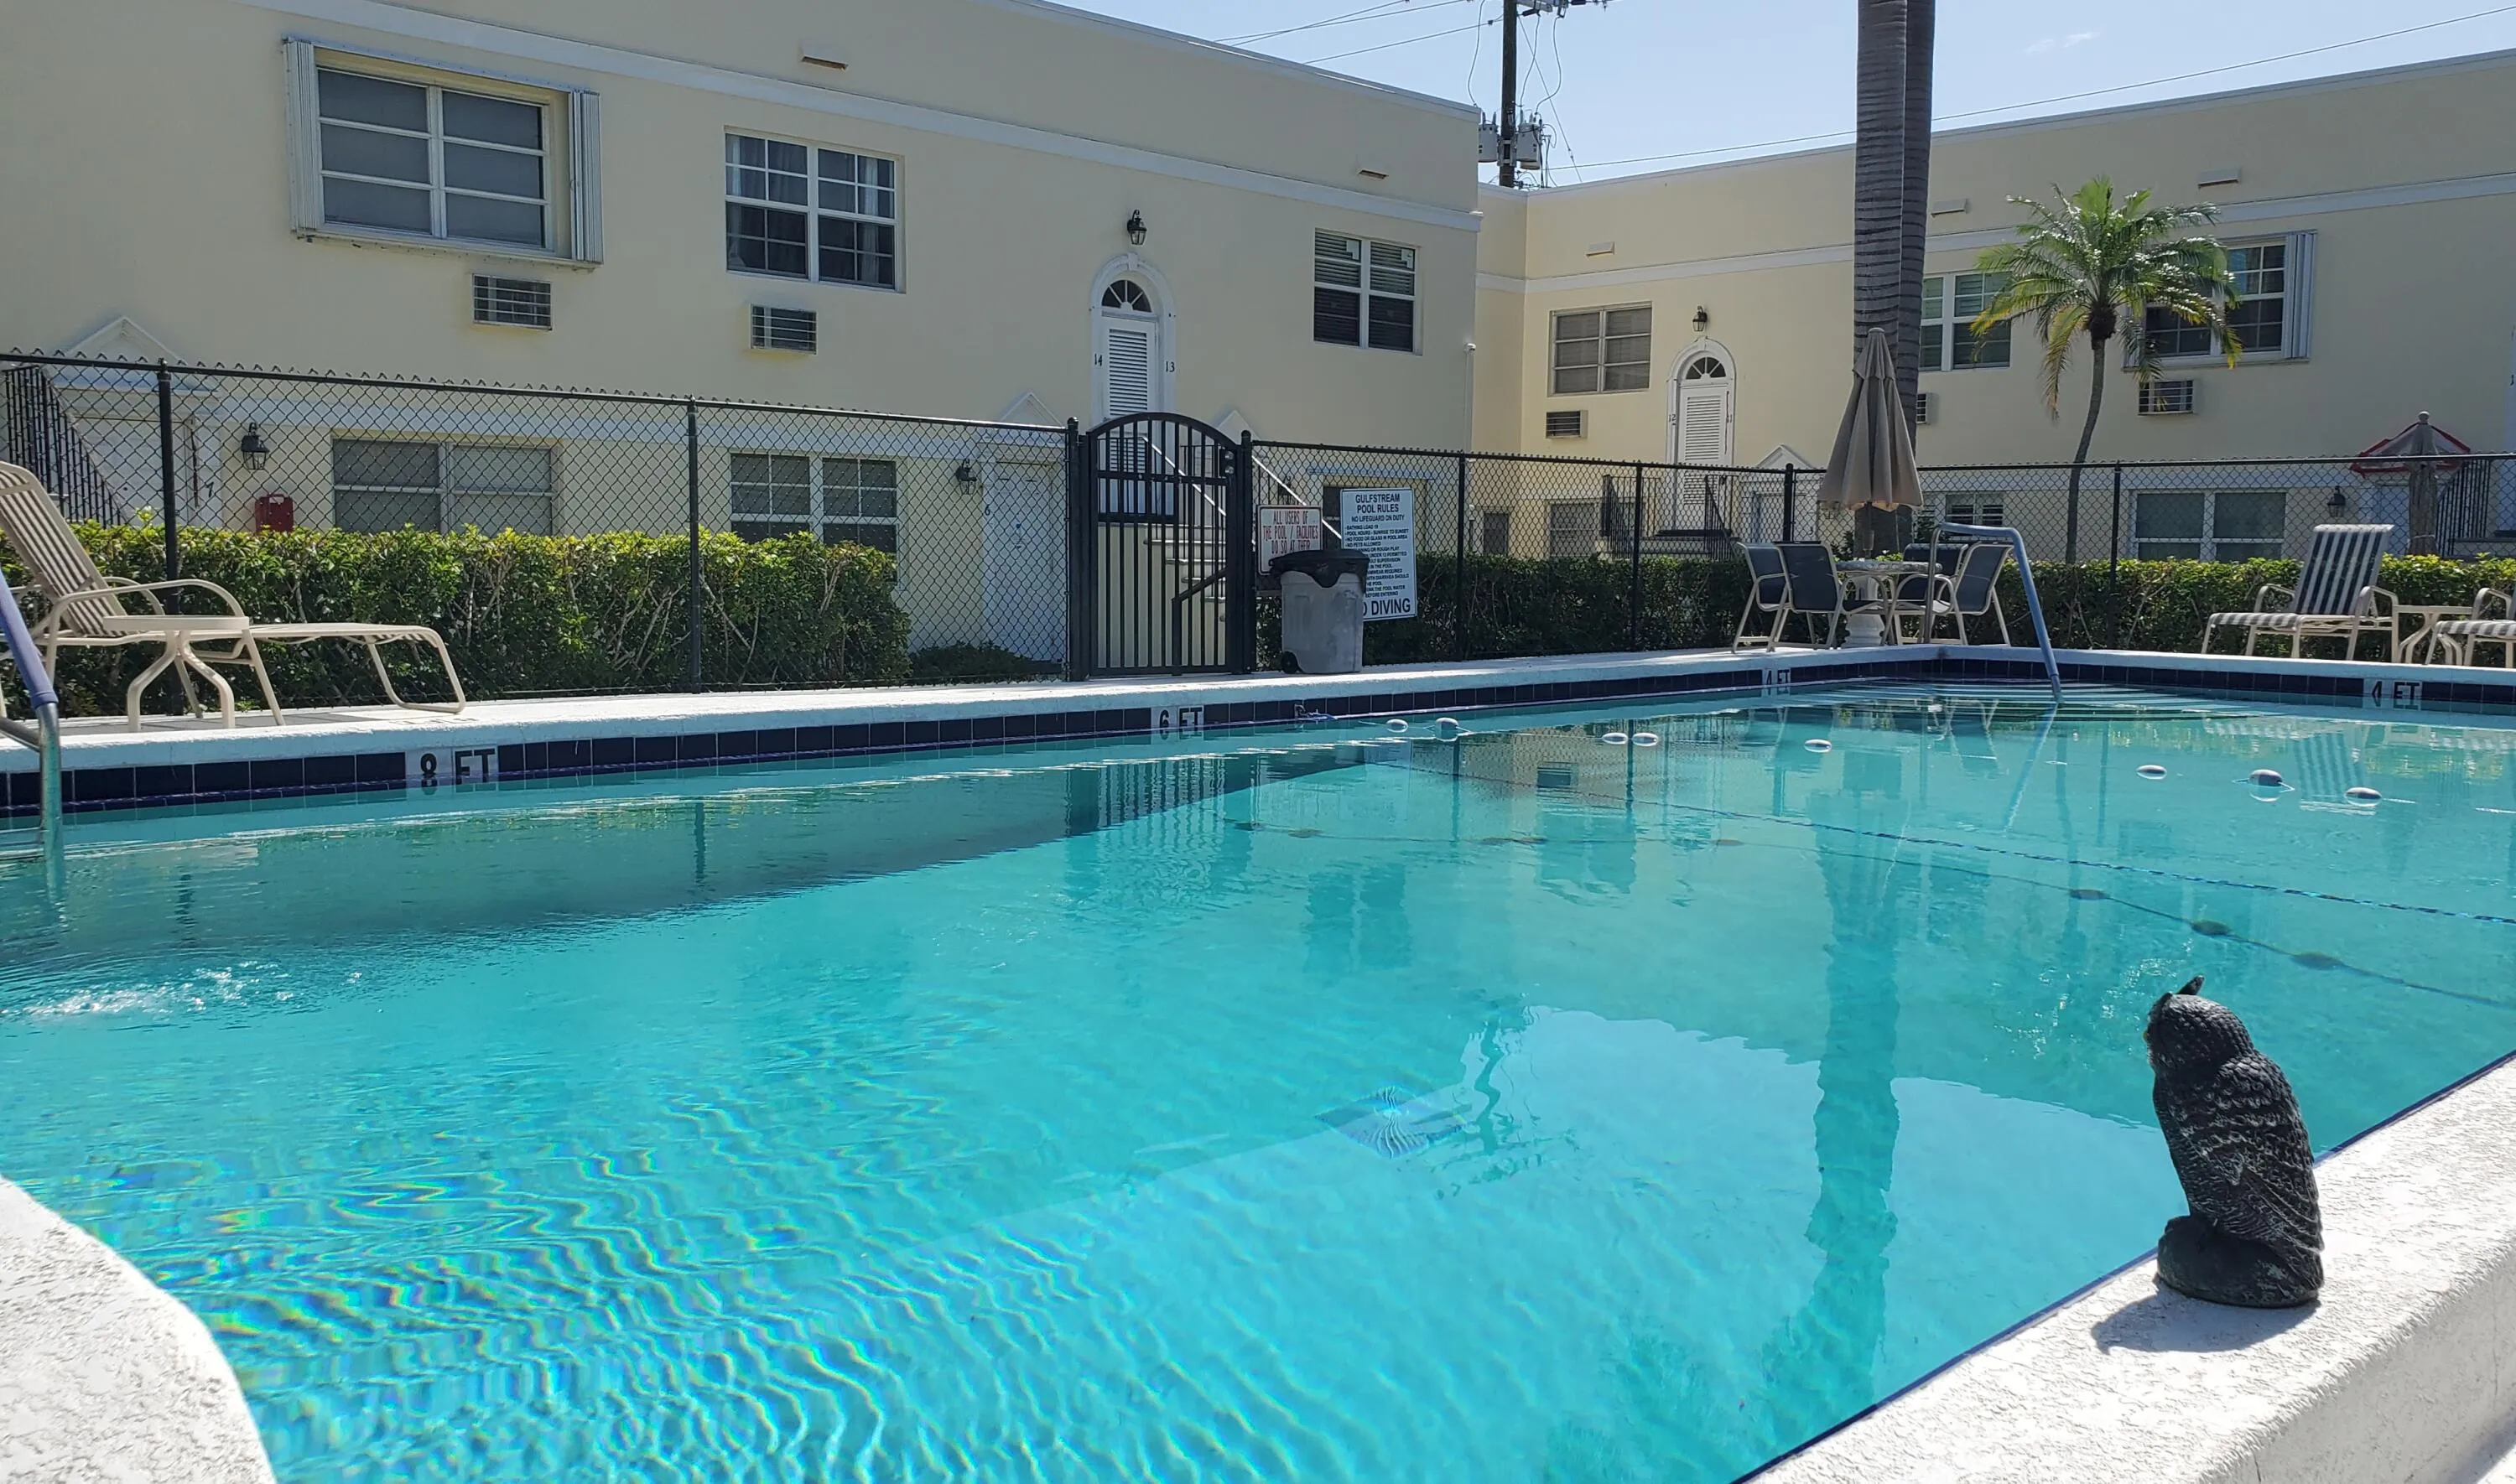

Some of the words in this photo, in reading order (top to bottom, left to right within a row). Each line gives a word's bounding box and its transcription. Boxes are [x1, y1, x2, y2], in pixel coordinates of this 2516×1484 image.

[1094, 353, 1103, 366] 14
[1165, 361, 1175, 372] 13
[1669, 413, 1676, 423] 12
[1355, 493, 1400, 503] GULFSTREAM
[1357, 504, 1375, 513] POOL
[1377, 503, 1399, 513] RULES
[1273, 511, 1282, 525] ALL
[1285, 511, 1300, 525] USERS
[1302, 511, 1308, 525] OF
[1275, 525, 1287, 539] POOL
[1371, 598, 1411, 615] DIVING
[1178, 706, 1203, 731] FT
[454, 748, 496, 785] FT
